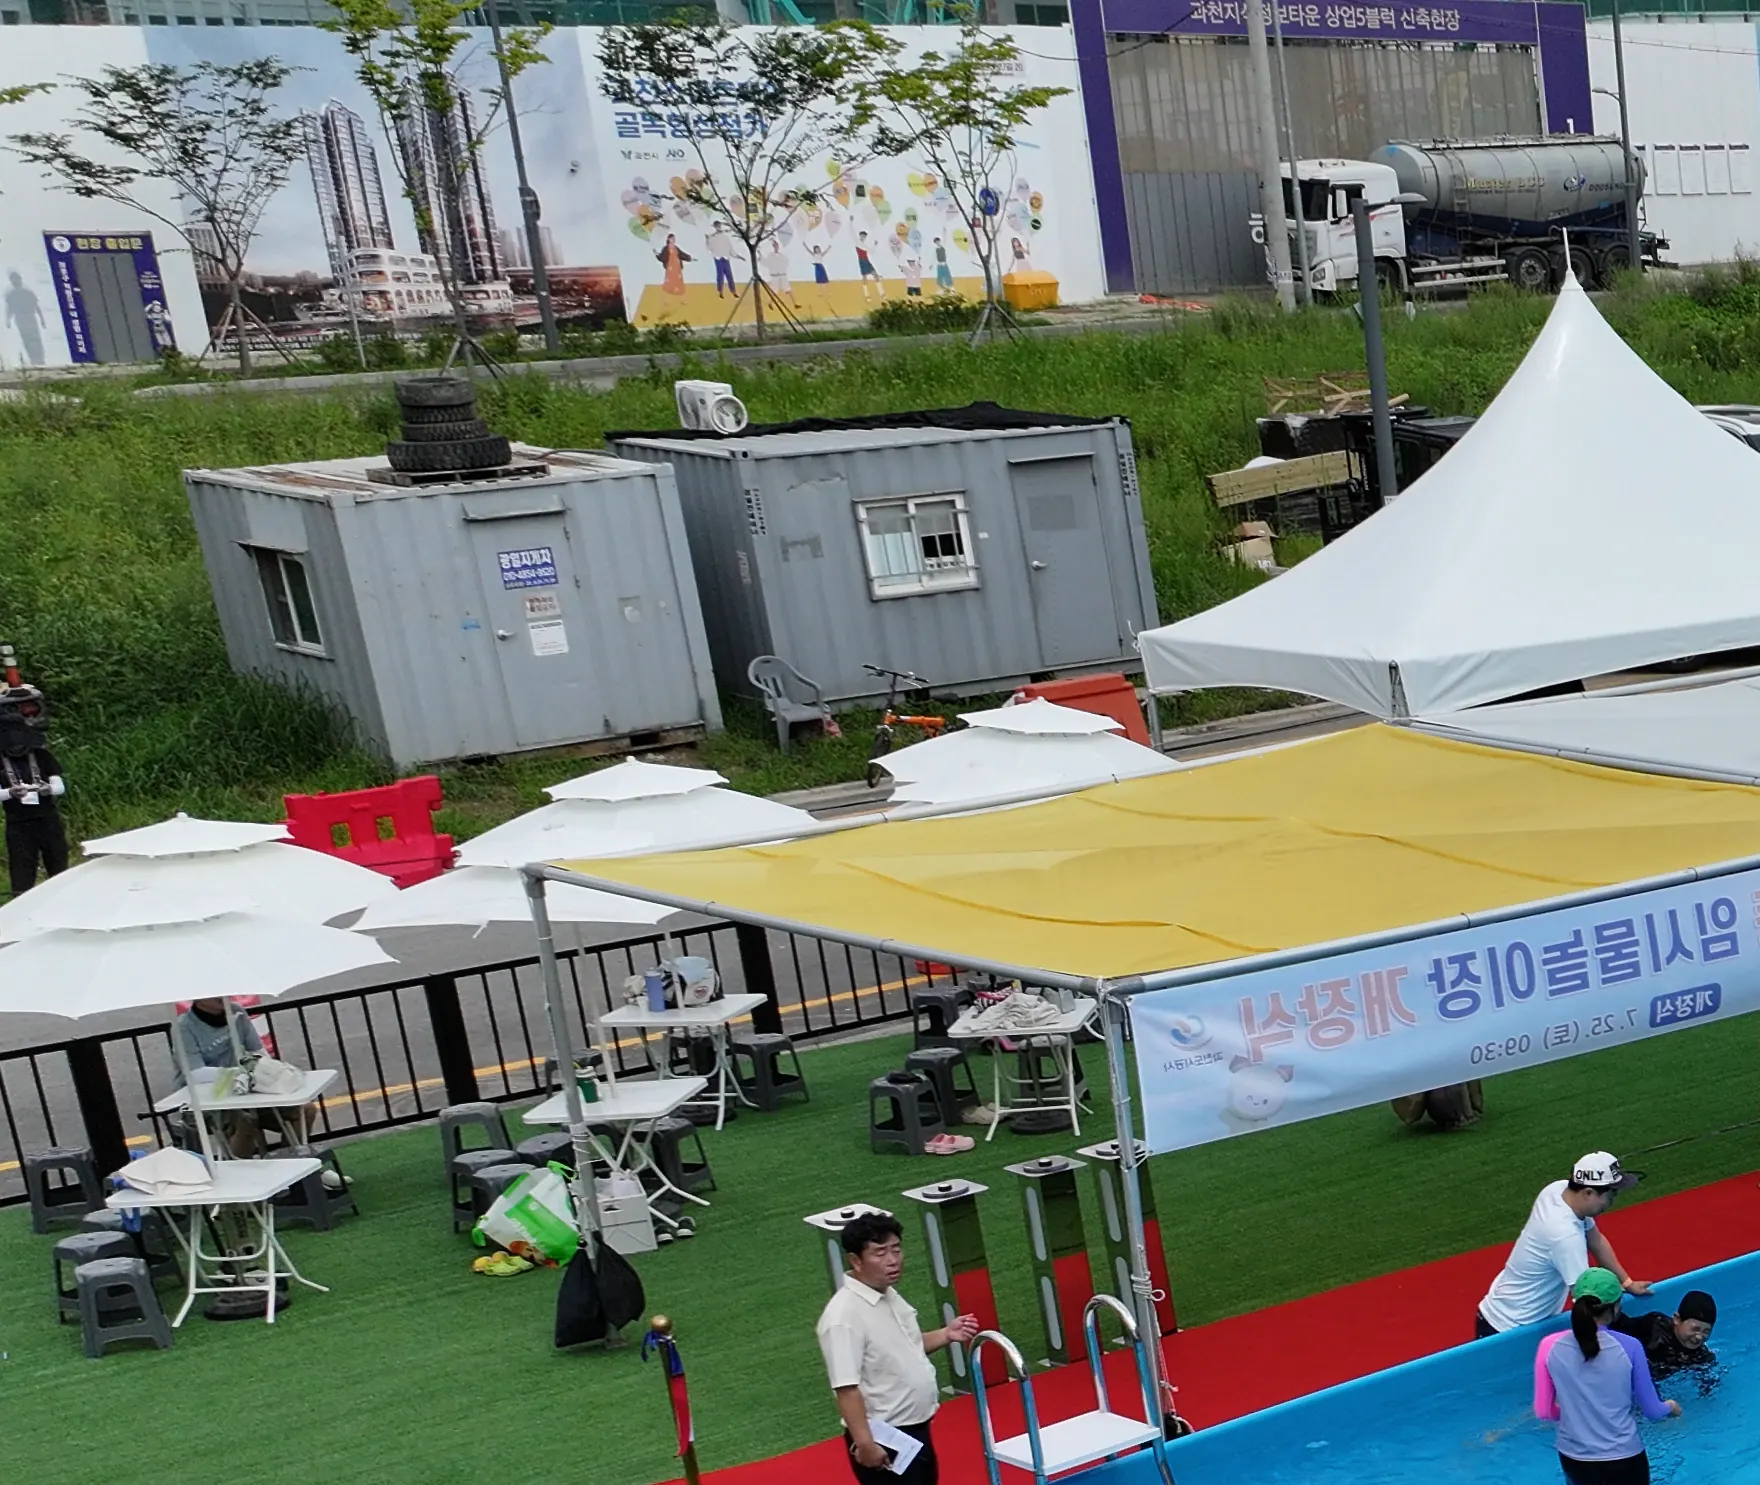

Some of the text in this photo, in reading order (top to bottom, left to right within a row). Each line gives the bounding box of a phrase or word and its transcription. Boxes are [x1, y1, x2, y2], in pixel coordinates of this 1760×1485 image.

[1189, 1, 1460, 31] 과천지정보타운 상업5블럭 신축현장
[1576, 1169, 1605, 1181] ONLY
